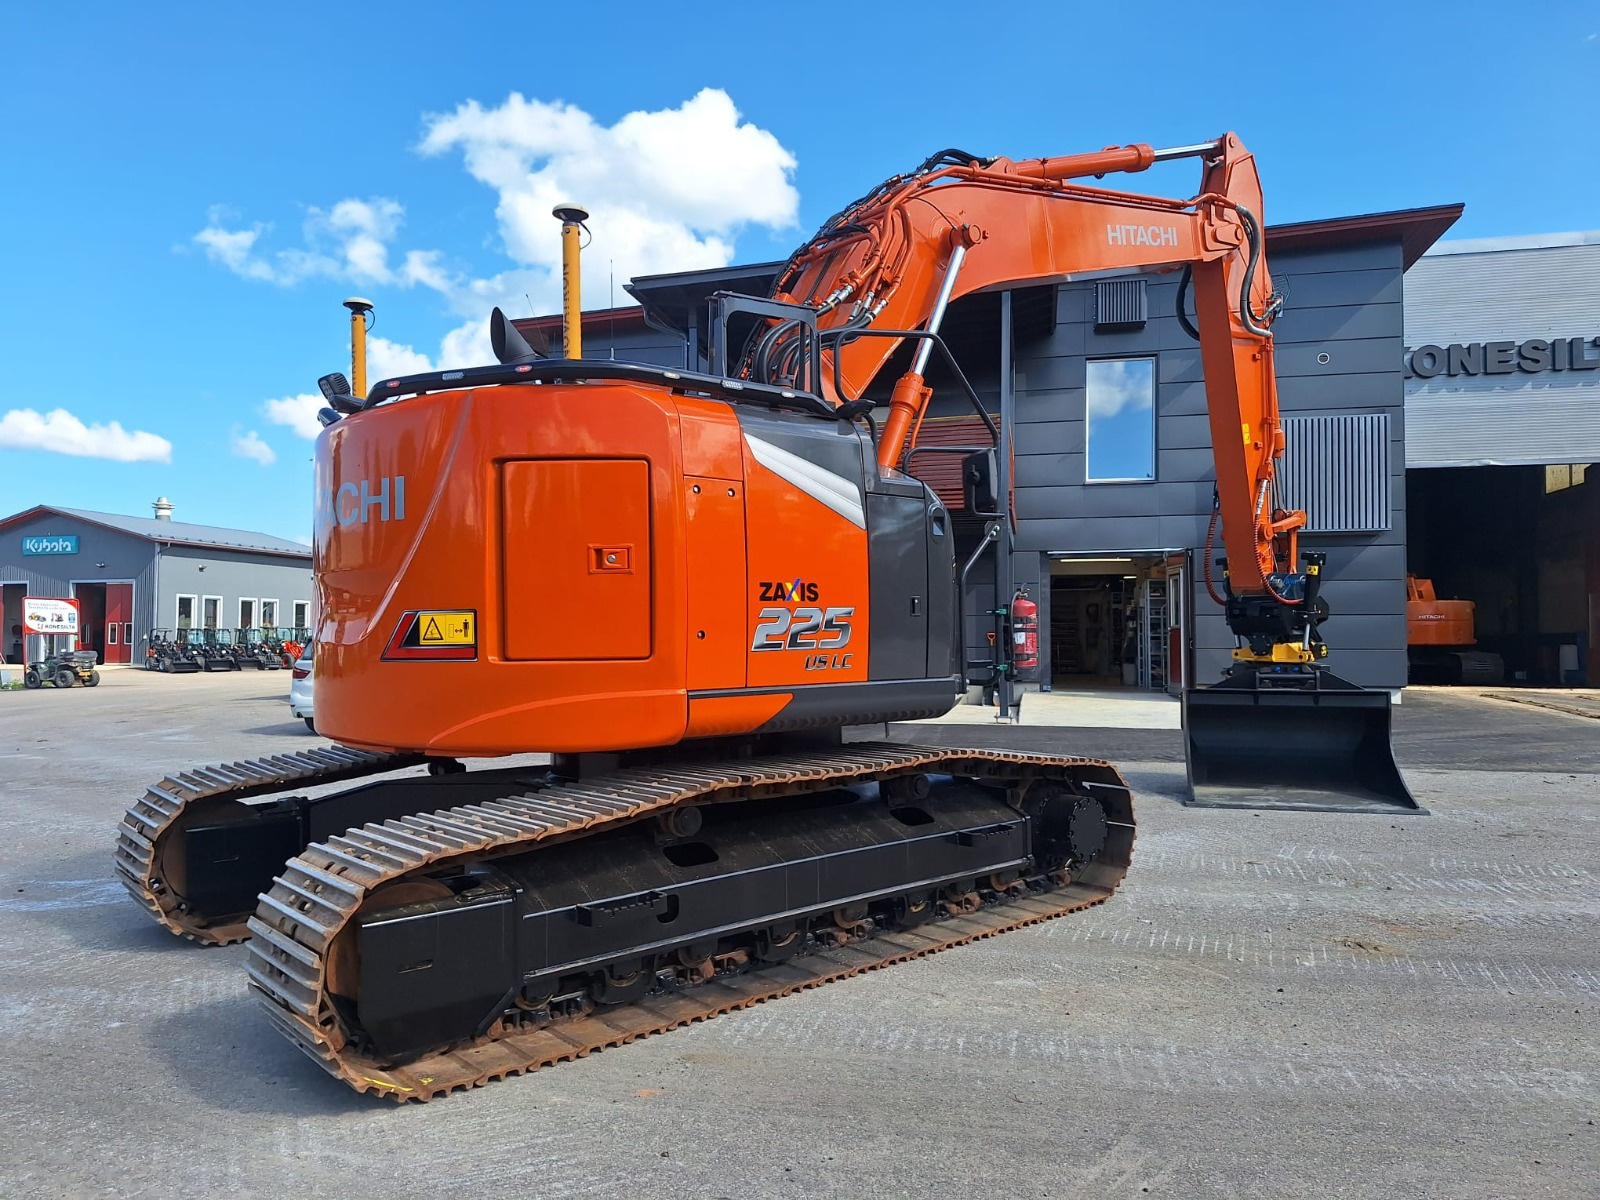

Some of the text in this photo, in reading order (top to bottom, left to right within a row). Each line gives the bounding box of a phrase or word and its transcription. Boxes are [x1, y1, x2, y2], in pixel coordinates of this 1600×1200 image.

[1106, 224, 1179, 247] HITACHI
[1403, 336, 1600, 379] ONESIL
[26, 538, 72, 553] Kubota
[759, 578, 819, 602] ZAXIS
[751, 607, 855, 651] 225
[804, 653, 854, 671] US LC
